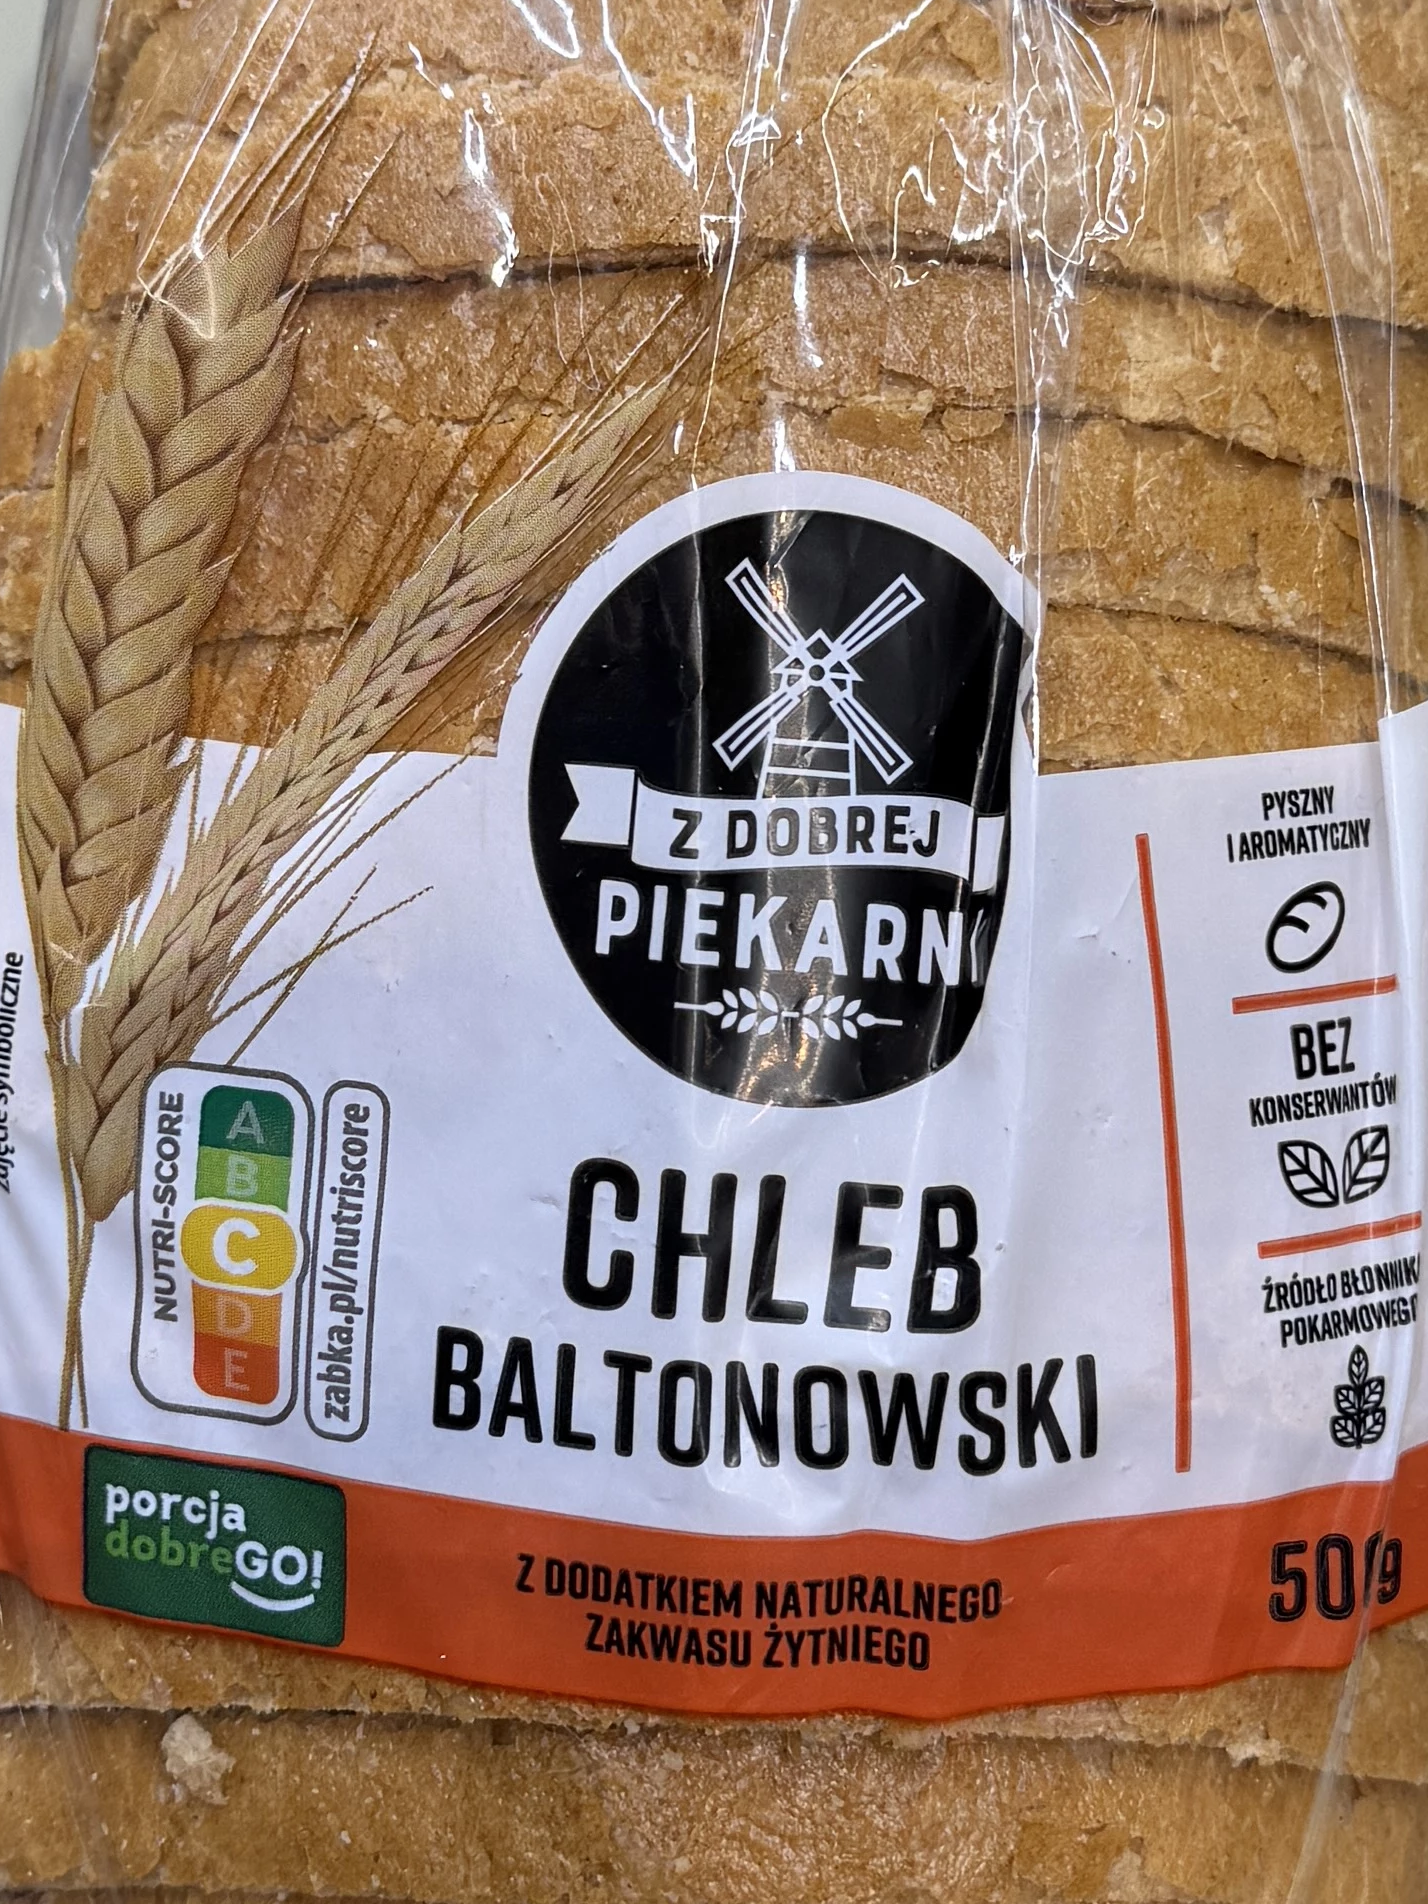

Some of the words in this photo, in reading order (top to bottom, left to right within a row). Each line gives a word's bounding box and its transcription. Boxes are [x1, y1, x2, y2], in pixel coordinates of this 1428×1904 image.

[1261, 785, 1334, 821] PYSZNY
[669, 809, 703, 859] Z
[726, 805, 940, 859] DOBREJ
[1227, 833, 1235, 863] I
[1239, 818, 1371, 862] AROMATYCZNY
[1290, 1016, 1355, 1080] BEZ
[229, 1100, 264, 1144] A
[1248, 1072, 1397, 1127] KONSERWANTÓW
[226, 1157, 258, 1197] B
[152, 1092, 184, 1322] NUTRI-SCORE
[212, 1217, 261, 1276] C
[317, 1103, 370, 1423] zabka.pl/nutriscore
[562, 1157, 982, 1334] CHLEB
[217, 1298, 249, 1337] D
[1261, 1272, 1338, 1313] ŹRÓDŁO
[224, 1350, 250, 1392] E
[432, 1326, 1098, 1477] BALTONOWSKI
[104, 1483, 247, 1540] porcja
[515, 1553, 535, 1594] Z
[545, 1558, 743, 1619] DODATKIEM
[755, 1574, 1002, 1624] NATURALNEGO
[584, 1612, 751, 1667] ZAKWASU
[763, 1622, 930, 1671] ŻYTNIEGO
